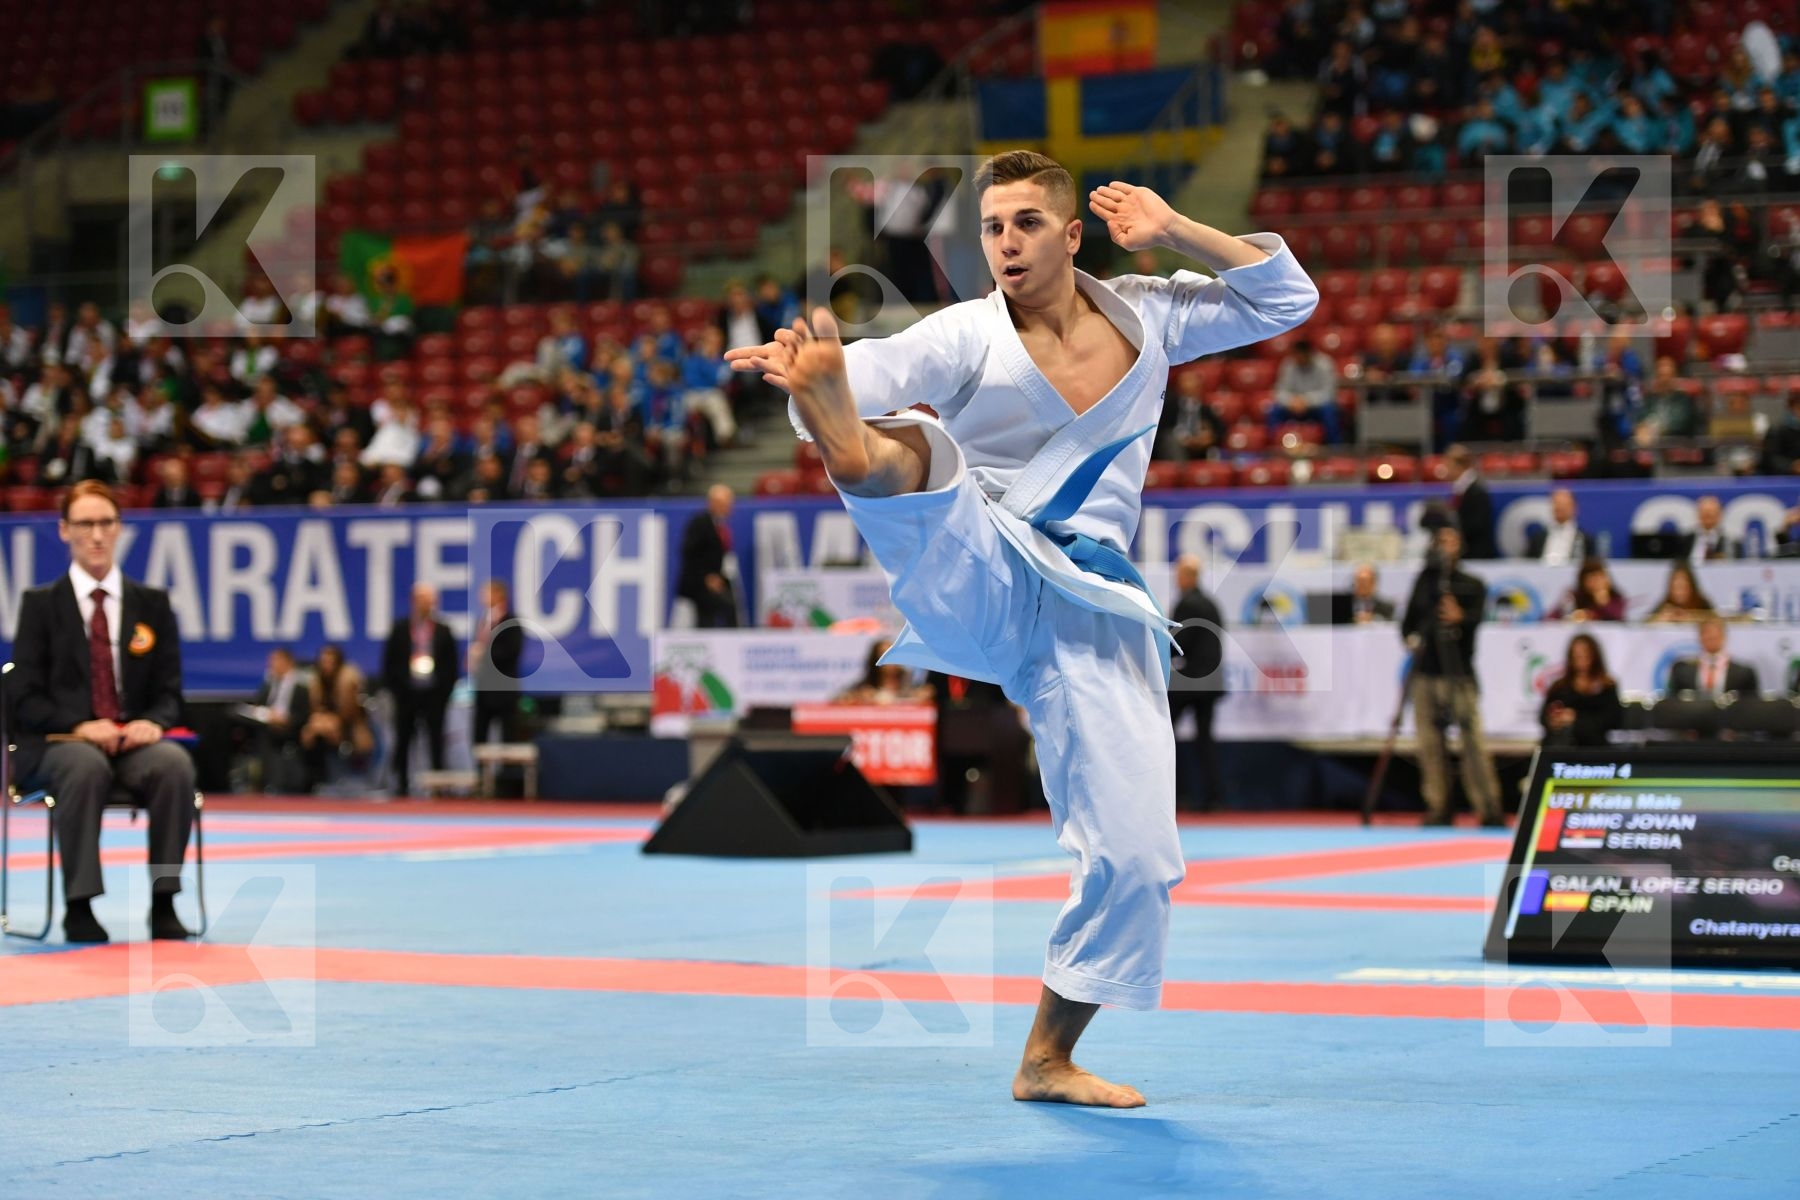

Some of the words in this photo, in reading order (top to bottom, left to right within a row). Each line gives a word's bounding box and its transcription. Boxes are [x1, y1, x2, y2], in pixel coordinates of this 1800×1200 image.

[112, 511, 476, 643] ARATE
[851, 729, 933, 769] CTOR
[1552, 762, 1616, 779] Tatami
[1617, 763, 1632, 779] 4
[1549, 792, 1584, 809] U21
[1588, 793, 1633, 810] Kata
[1636, 793, 1682, 810] Male
[1566, 813, 1623, 829] SIMIC
[1625, 814, 1696, 831] JOVAN
[1606, 833, 1682, 850] SERBIA
[1772, 855, 1800, 874] Go
[1550, 875, 1699, 894] GALAN_LOPEZ
[1702, 877, 1784, 895] SERGIO
[1589, 896, 1653, 913] SPAIN
[1689, 918, 1800, 940] Chatanyara
